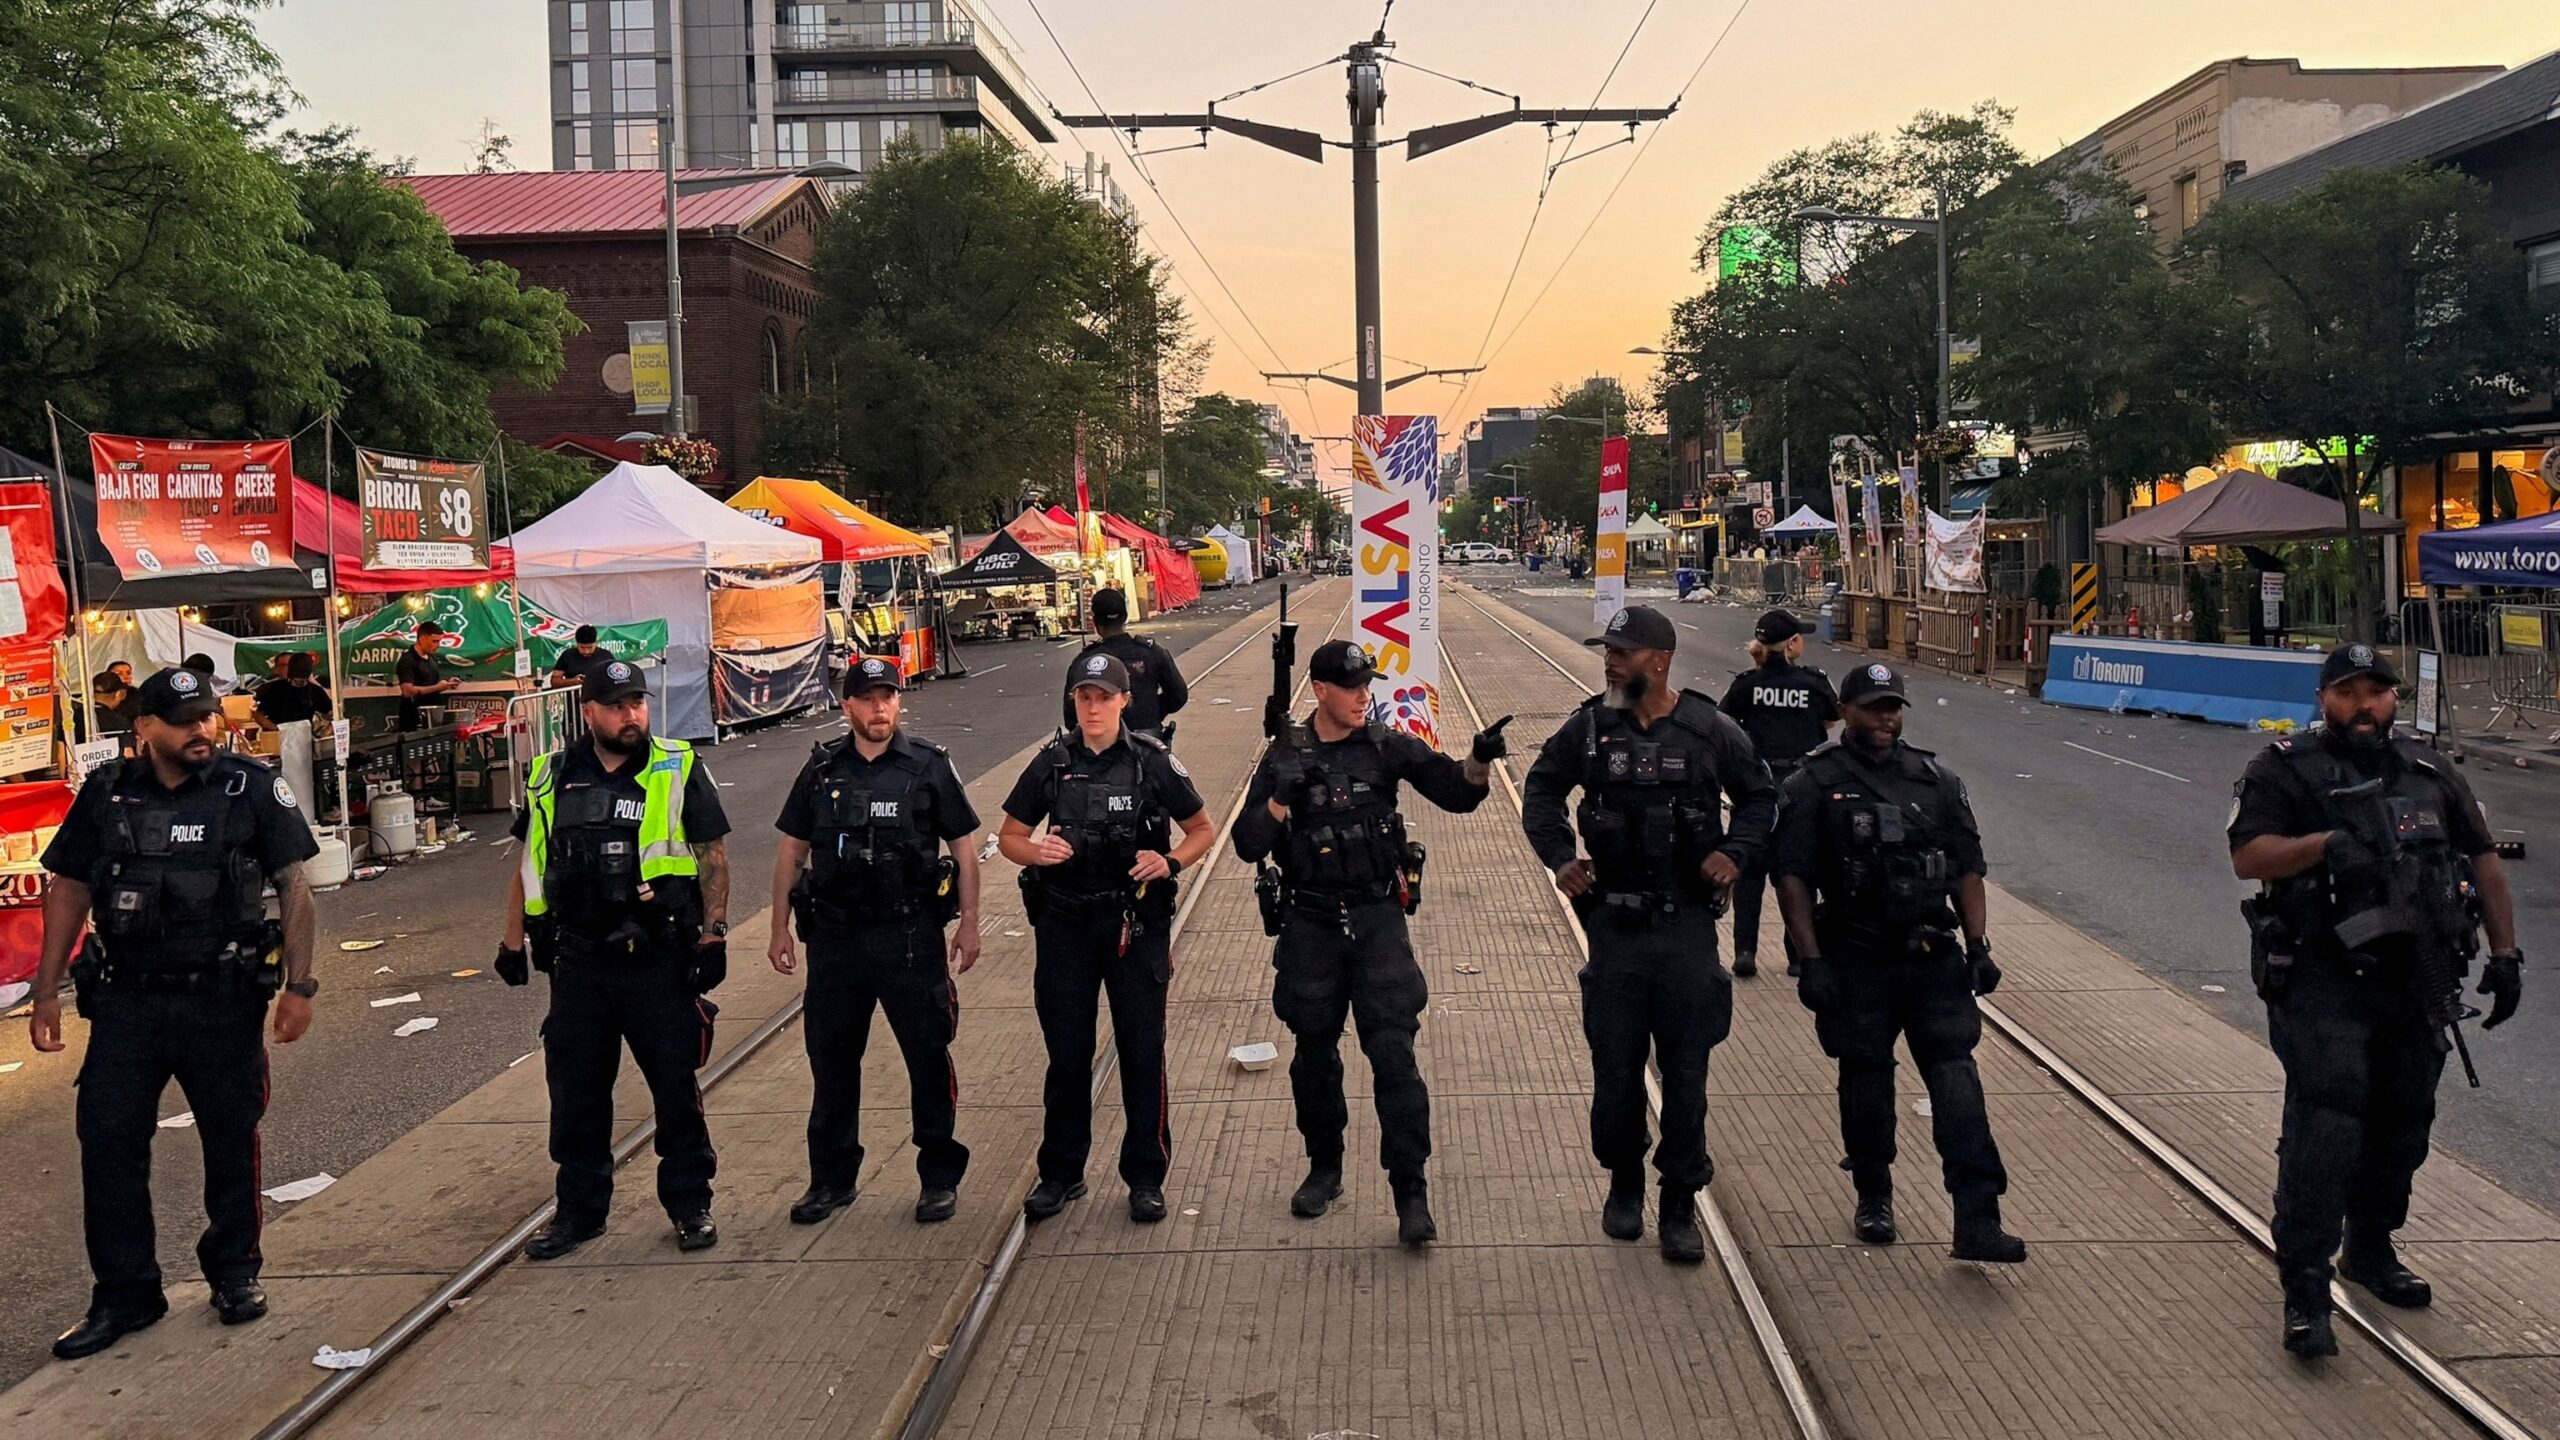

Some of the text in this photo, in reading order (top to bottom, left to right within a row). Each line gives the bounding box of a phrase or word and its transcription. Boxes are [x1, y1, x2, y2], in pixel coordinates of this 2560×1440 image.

[632, 352, 661, 360] THINK
[633, 360, 668, 369] LOCAL
[636, 388, 670, 397] LOCAL
[383, 456, 408, 470] ATOMIC
[1603, 462, 1622, 477] SALSA
[99, 473, 160, 499] BAJA FISH
[167, 473, 223, 499] CARNITAS
[235, 473, 276, 498] CHEESE
[365, 479, 422, 511] BIRRIA
[180, 500, 209, 516] TACO
[233, 498, 278, 516] EMPANADA
[440, 487, 473, 537] $8
[371, 509, 419, 540] TACO
[973, 560, 1018, 573] BUILT
[2455, 546, 2560, 572] www.toro
[1418, 543, 1431, 631] IN TORONTO
[351, 648, 406, 664] JARRIT
[2091, 656, 2144, 686] TORONTO
[453, 700, 504, 711] FLAVOUR
[1753, 686, 1809, 708] POLICE
[82, 749, 113, 762] ORDER
[614, 799, 646, 821] POLIC
[870, 802, 898, 817] POLICE
[170, 825, 205, 842] POLICE
